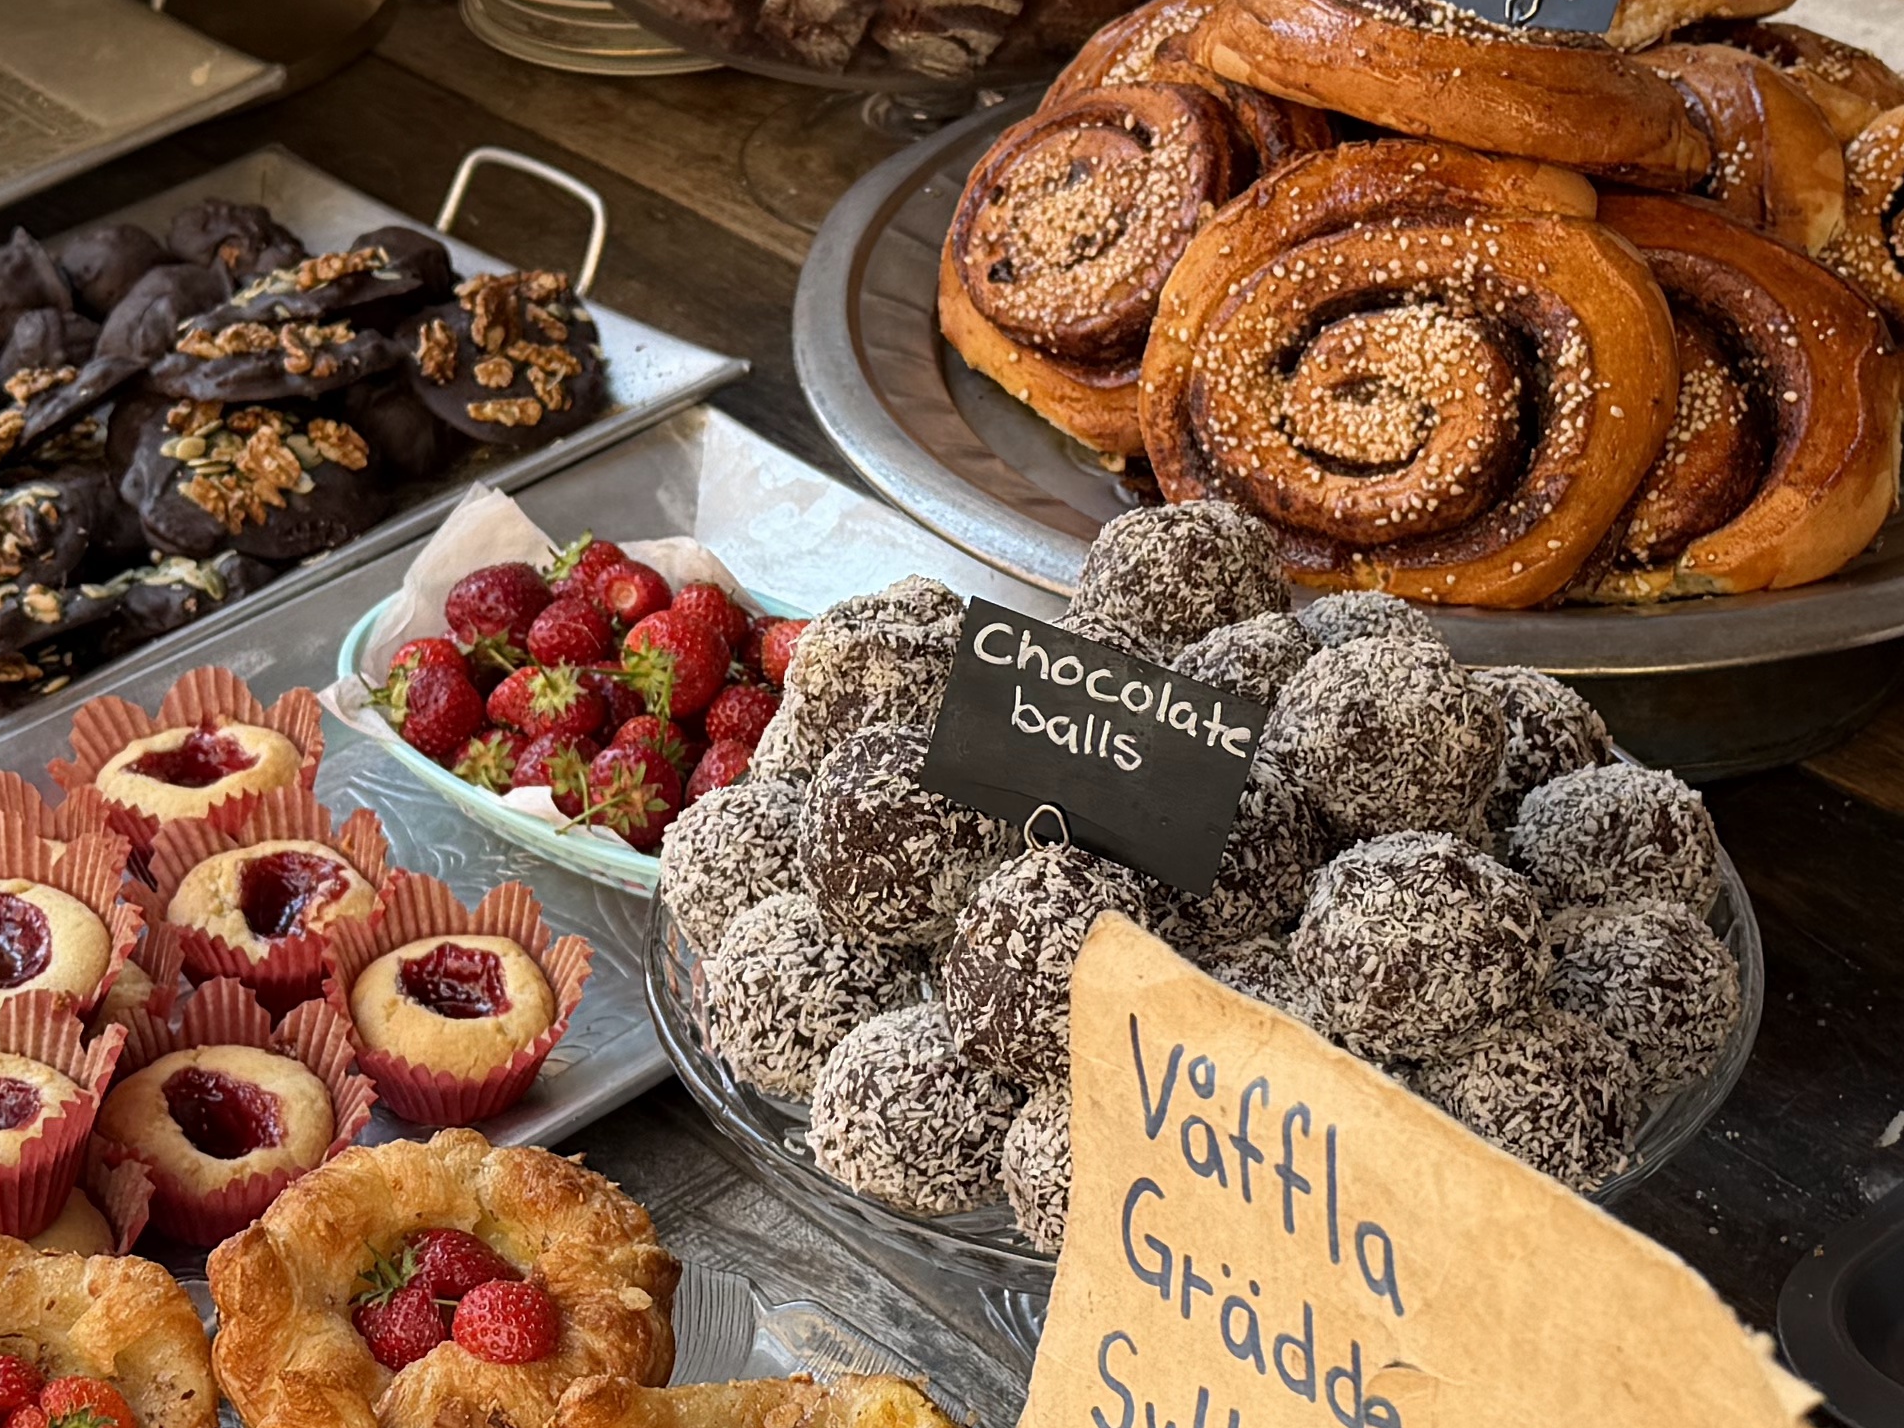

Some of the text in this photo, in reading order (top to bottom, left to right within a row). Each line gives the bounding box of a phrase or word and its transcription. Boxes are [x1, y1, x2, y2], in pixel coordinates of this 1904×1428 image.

[972, 621, 1253, 759] Chocolate
[1010, 684, 1144, 772] balls
[1127, 1013, 1408, 1317] Våffla
